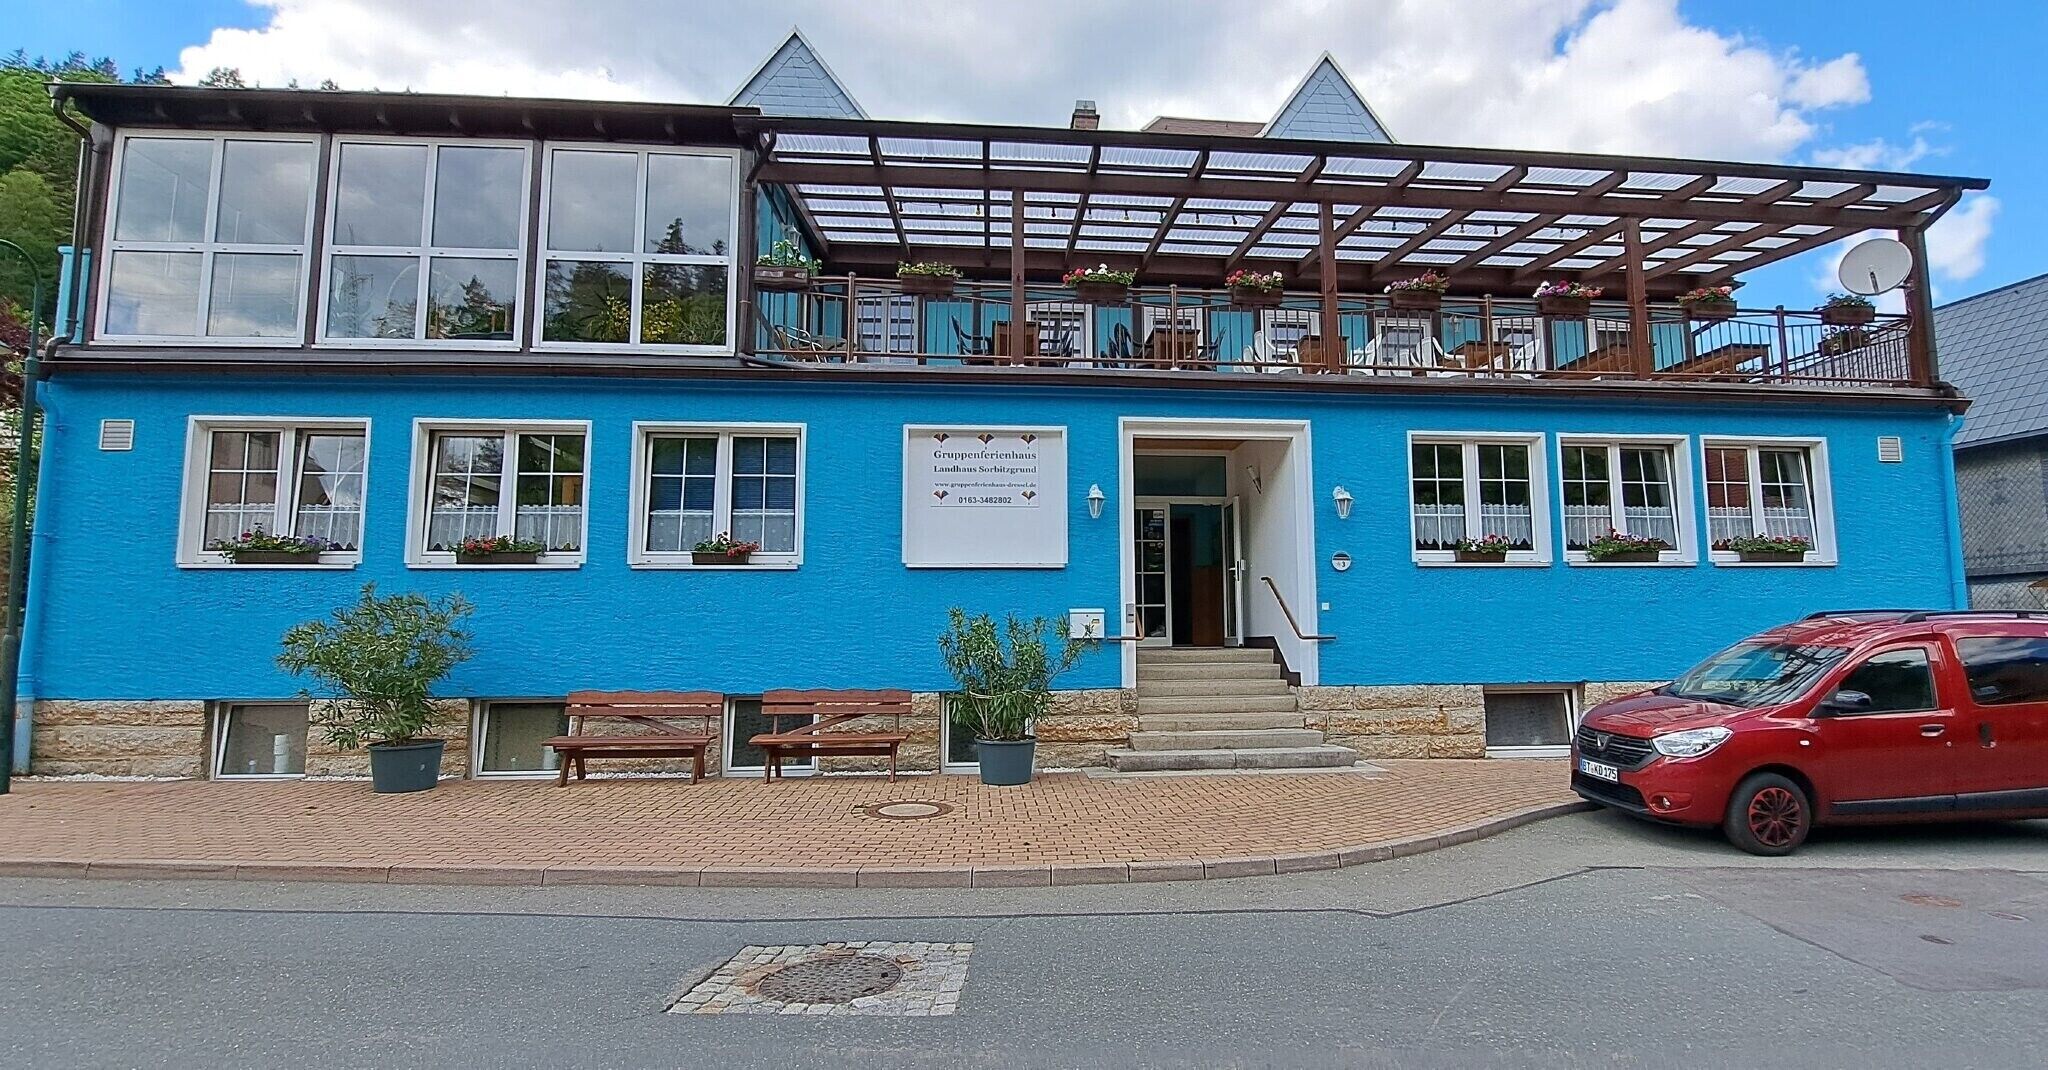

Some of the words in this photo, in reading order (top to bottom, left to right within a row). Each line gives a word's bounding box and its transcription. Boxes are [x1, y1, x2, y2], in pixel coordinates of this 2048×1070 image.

[934, 450, 1036, 460] Gruppenferienhaus
[934, 465, 977, 473] Landhaus
[979, 465, 1036, 475] Sorbitzgrund
[1604, 767, 1616, 779] 175
